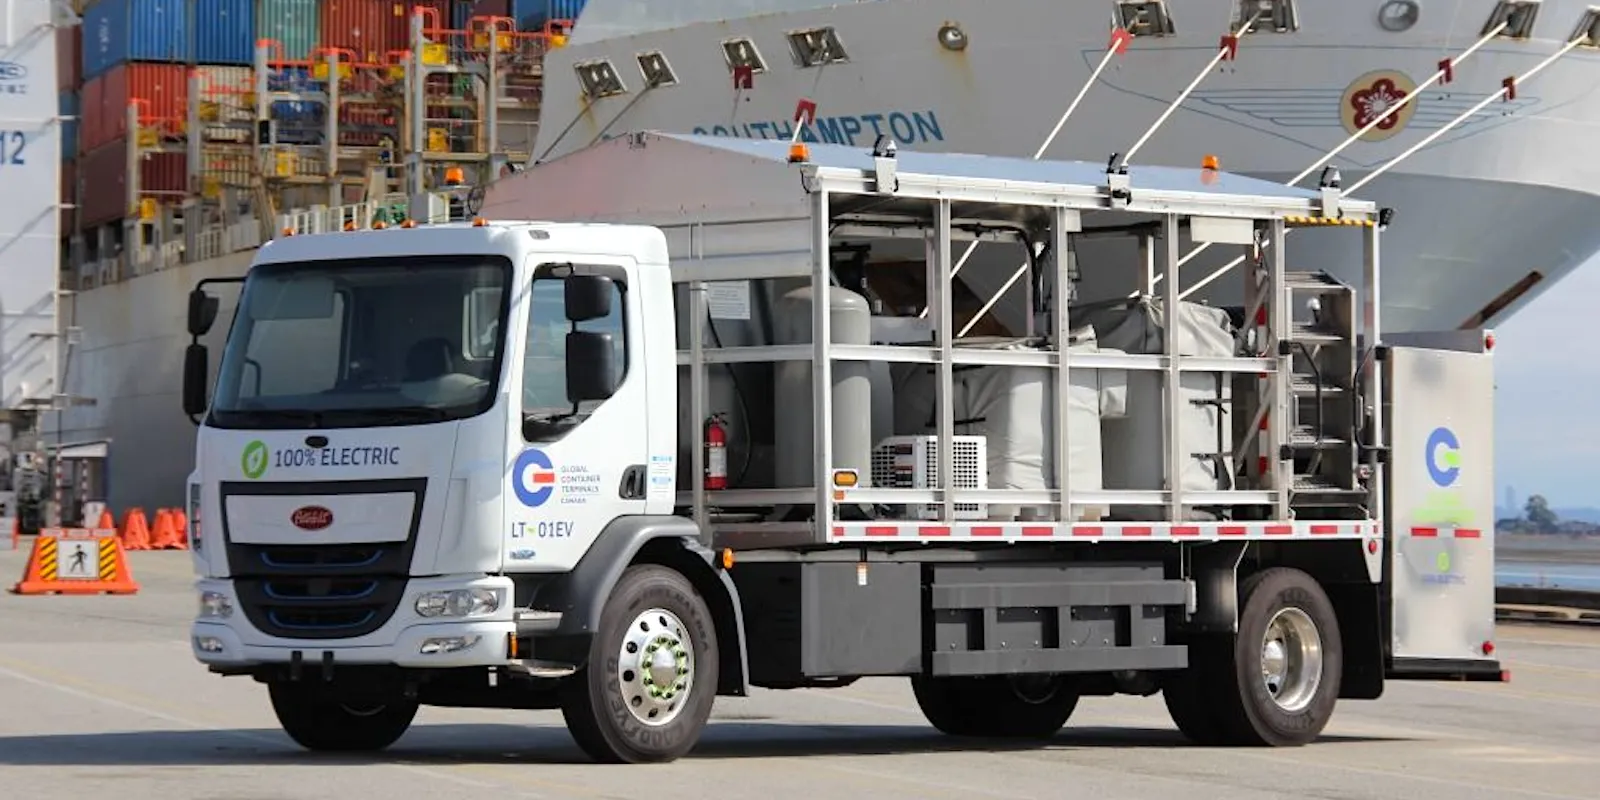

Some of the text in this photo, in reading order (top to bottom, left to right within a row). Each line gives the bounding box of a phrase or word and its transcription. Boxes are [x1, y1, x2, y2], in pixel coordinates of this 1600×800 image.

[274, 446, 400, 468] 100% ELECTRIC
[560, 465, 589, 473] GLOBAL
[560, 474, 601, 483] CONTAINER
[561, 484, 600, 493] TERMINALS
